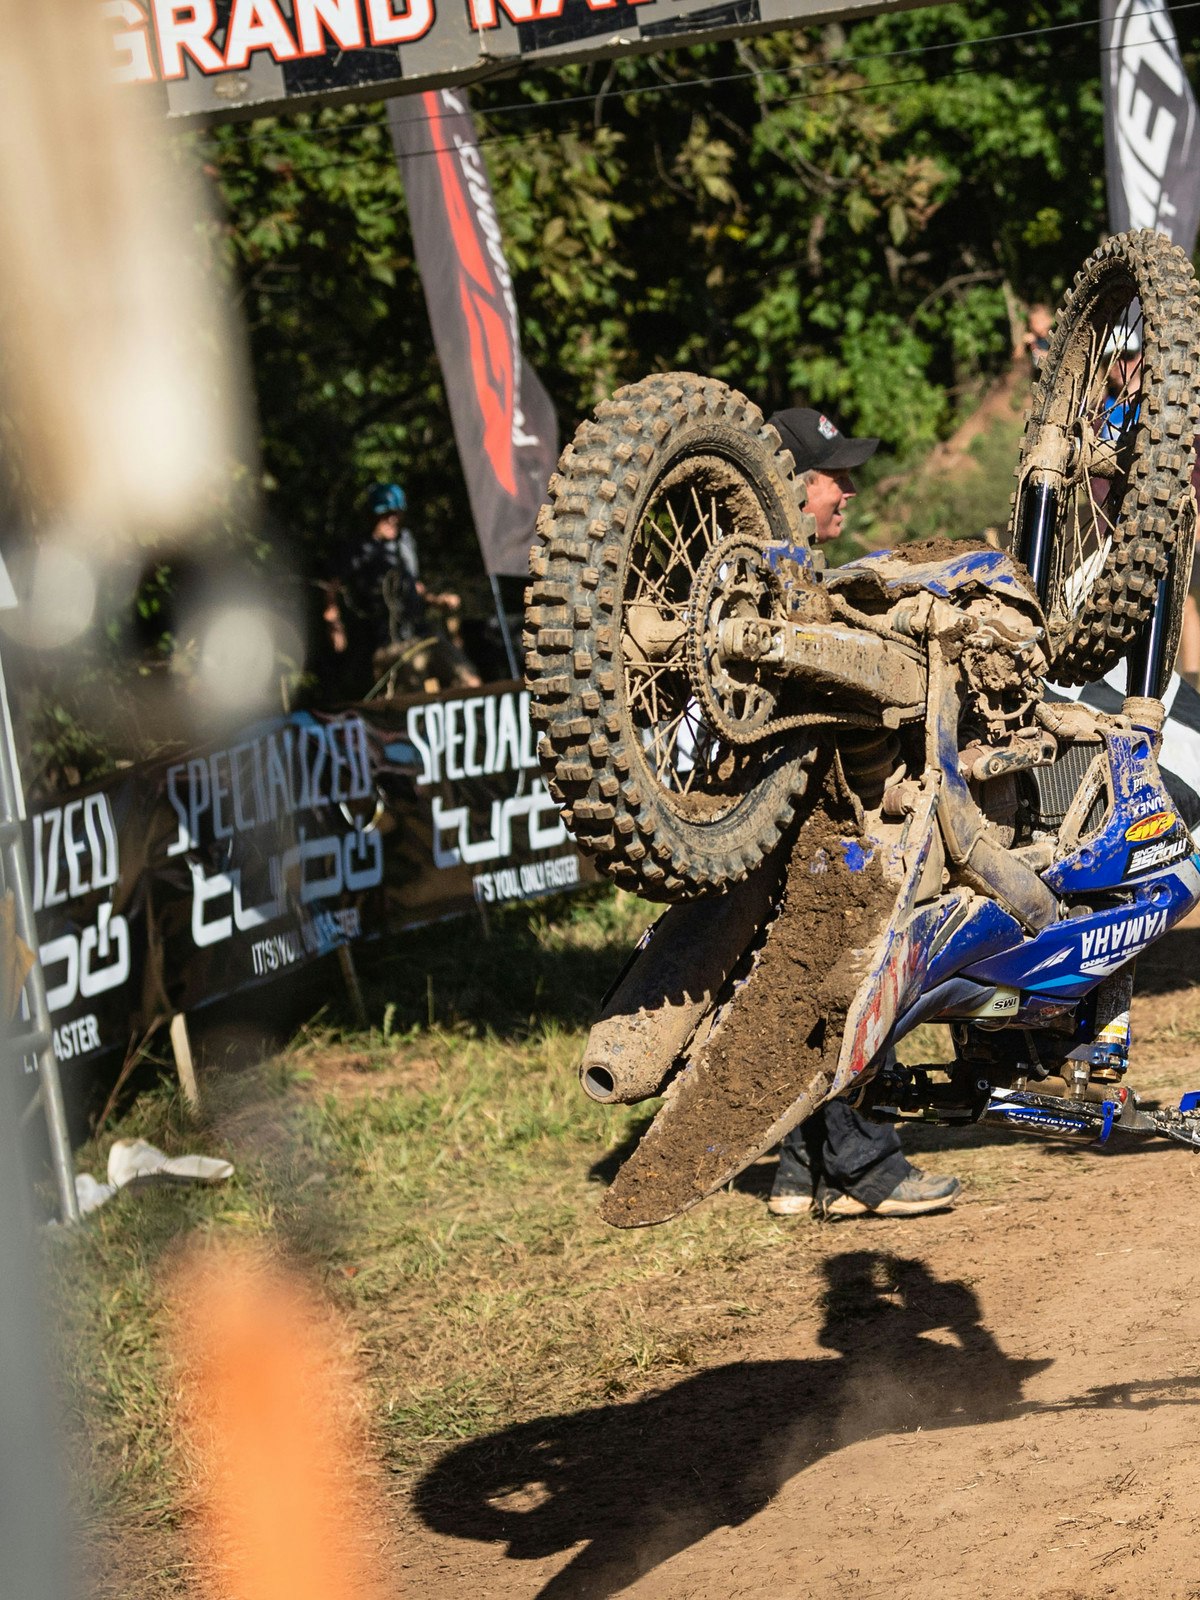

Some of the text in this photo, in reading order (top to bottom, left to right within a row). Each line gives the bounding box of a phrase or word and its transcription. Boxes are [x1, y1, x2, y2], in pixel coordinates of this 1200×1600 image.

[100, 0, 434, 84] GRAND
[407, 691, 546, 785] SPECIAL
[167, 717, 373, 856] SPECIALIZED
[1125, 811, 1176, 842] FMF
[1127, 837, 1188, 874] MOOSE
[1081, 908, 1169, 960] YAMAHA
[993, 997, 1018, 1010] IMS
[53, 1013, 102, 1062] ASTER
